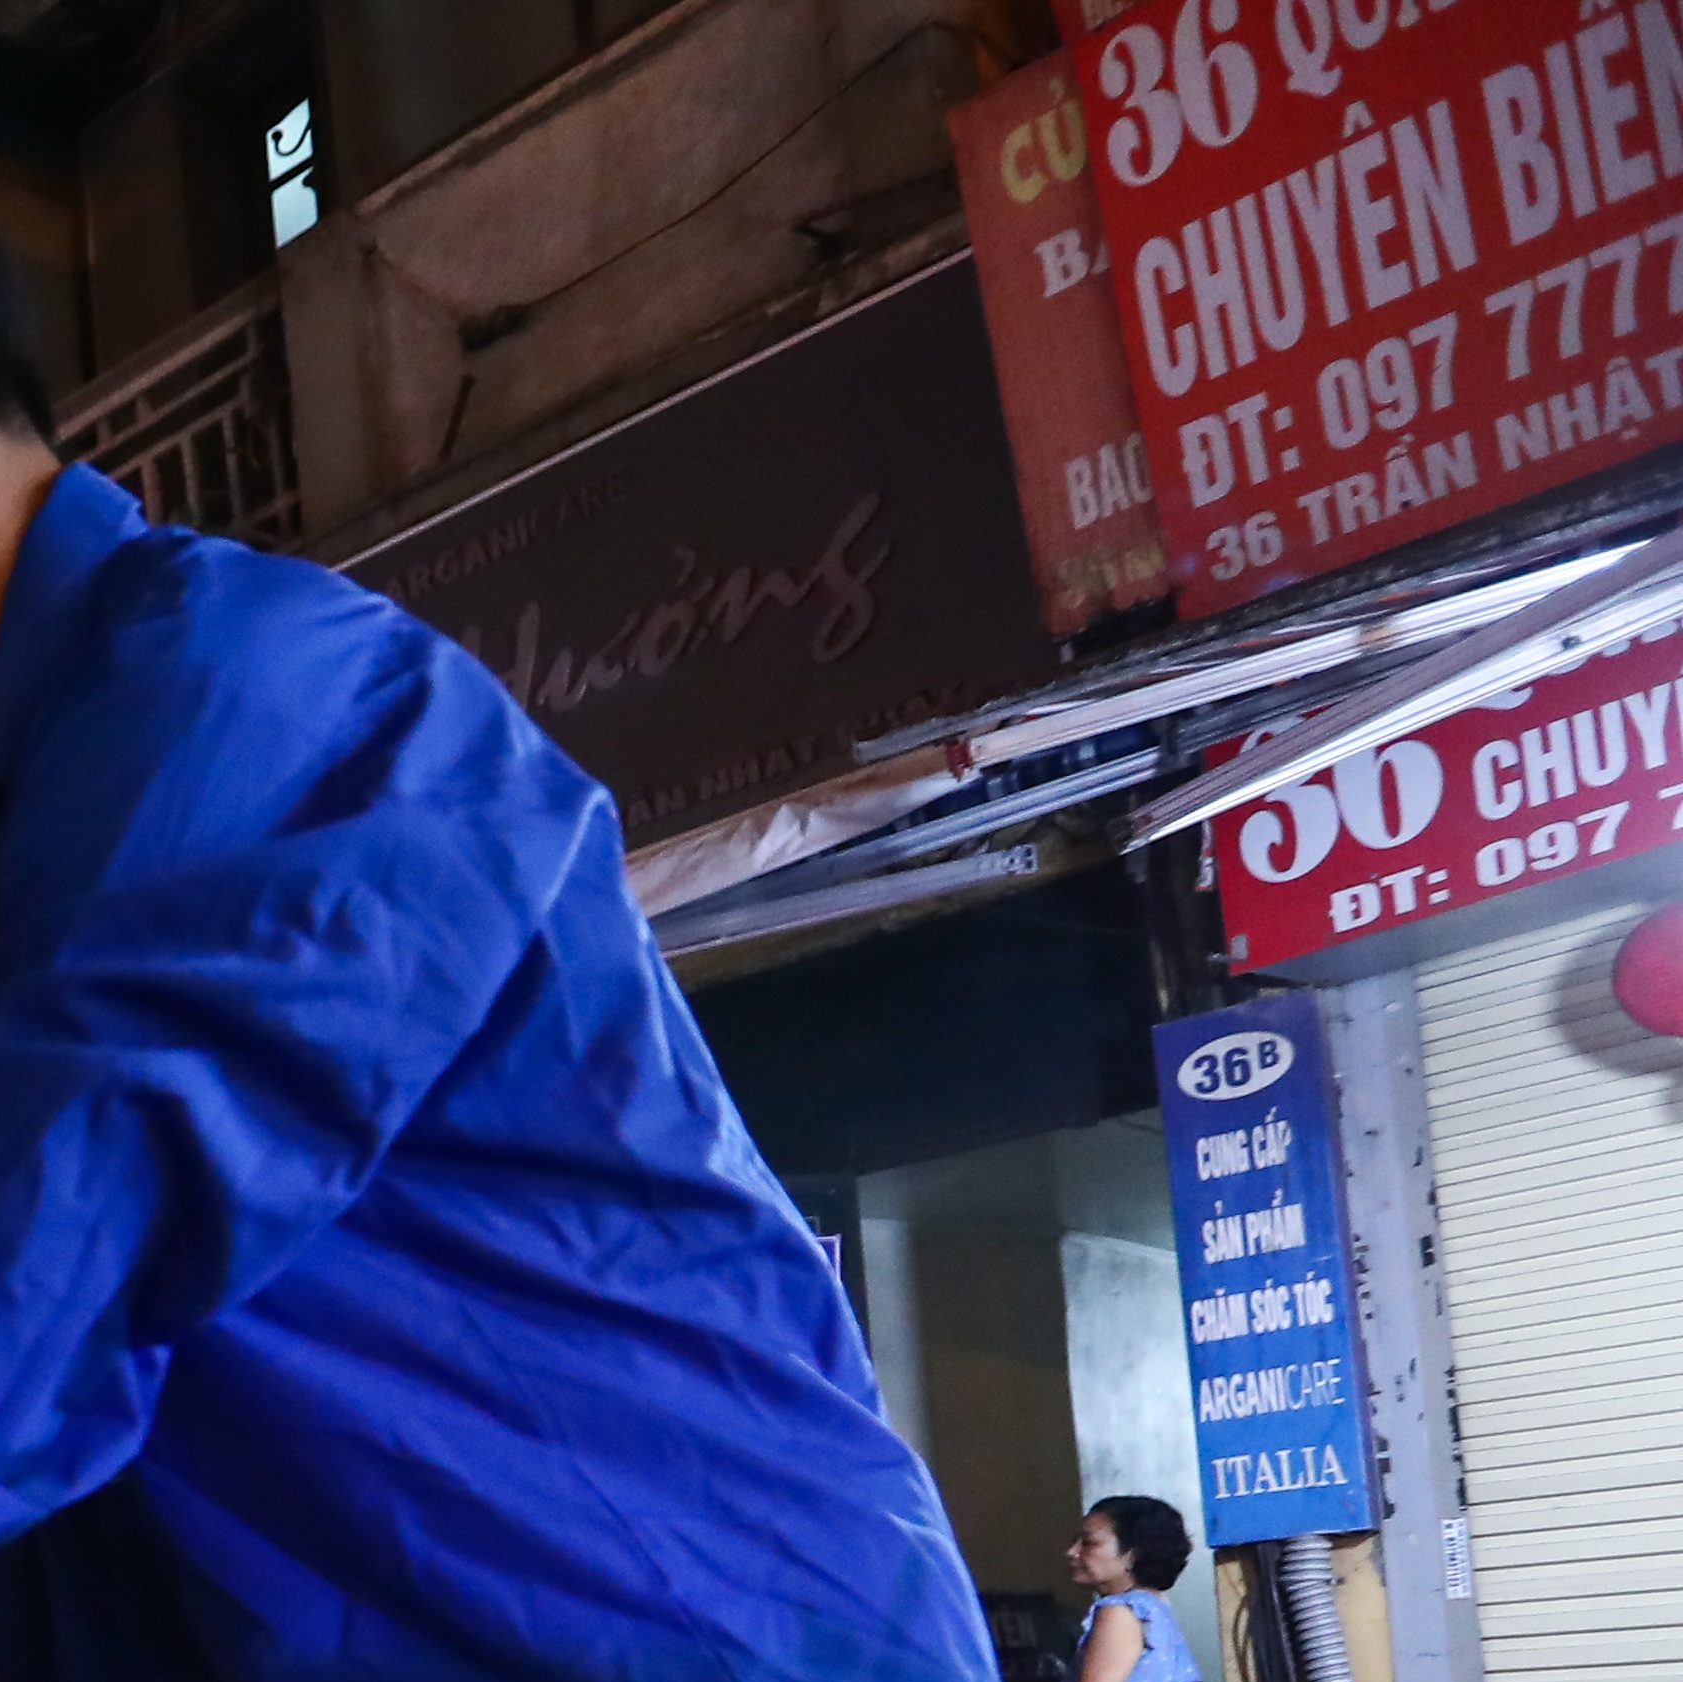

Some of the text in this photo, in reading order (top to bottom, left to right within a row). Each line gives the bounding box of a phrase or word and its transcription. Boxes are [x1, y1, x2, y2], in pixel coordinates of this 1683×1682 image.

[1097, 0, 1259, 188] 36
[1135, 99, 1478, 398] CHUYÊN
[1179, 393, 1301, 508] ĐT:
[1317, 314, 1459, 450] 097
[1205, 510, 1285, 582] 36
[1297, 432, 1479, 546] TRẦN
[1471, 680, 1683, 821] CHUY
[1328, 865, 1451, 933] ĐT:
[1475, 801, 1630, 886] 097
[1196, 1107, 1291, 1181] CUNG CẤP
[1202, 1199, 1245, 1265] SẢN
[1250, 1277, 1292, 1335] SÓC
[1293, 1270, 1334, 1326] TÓC
[1200, 1358, 1346, 1424] ARGANICARE
[1212, 1444, 1349, 1500] ITALIA
